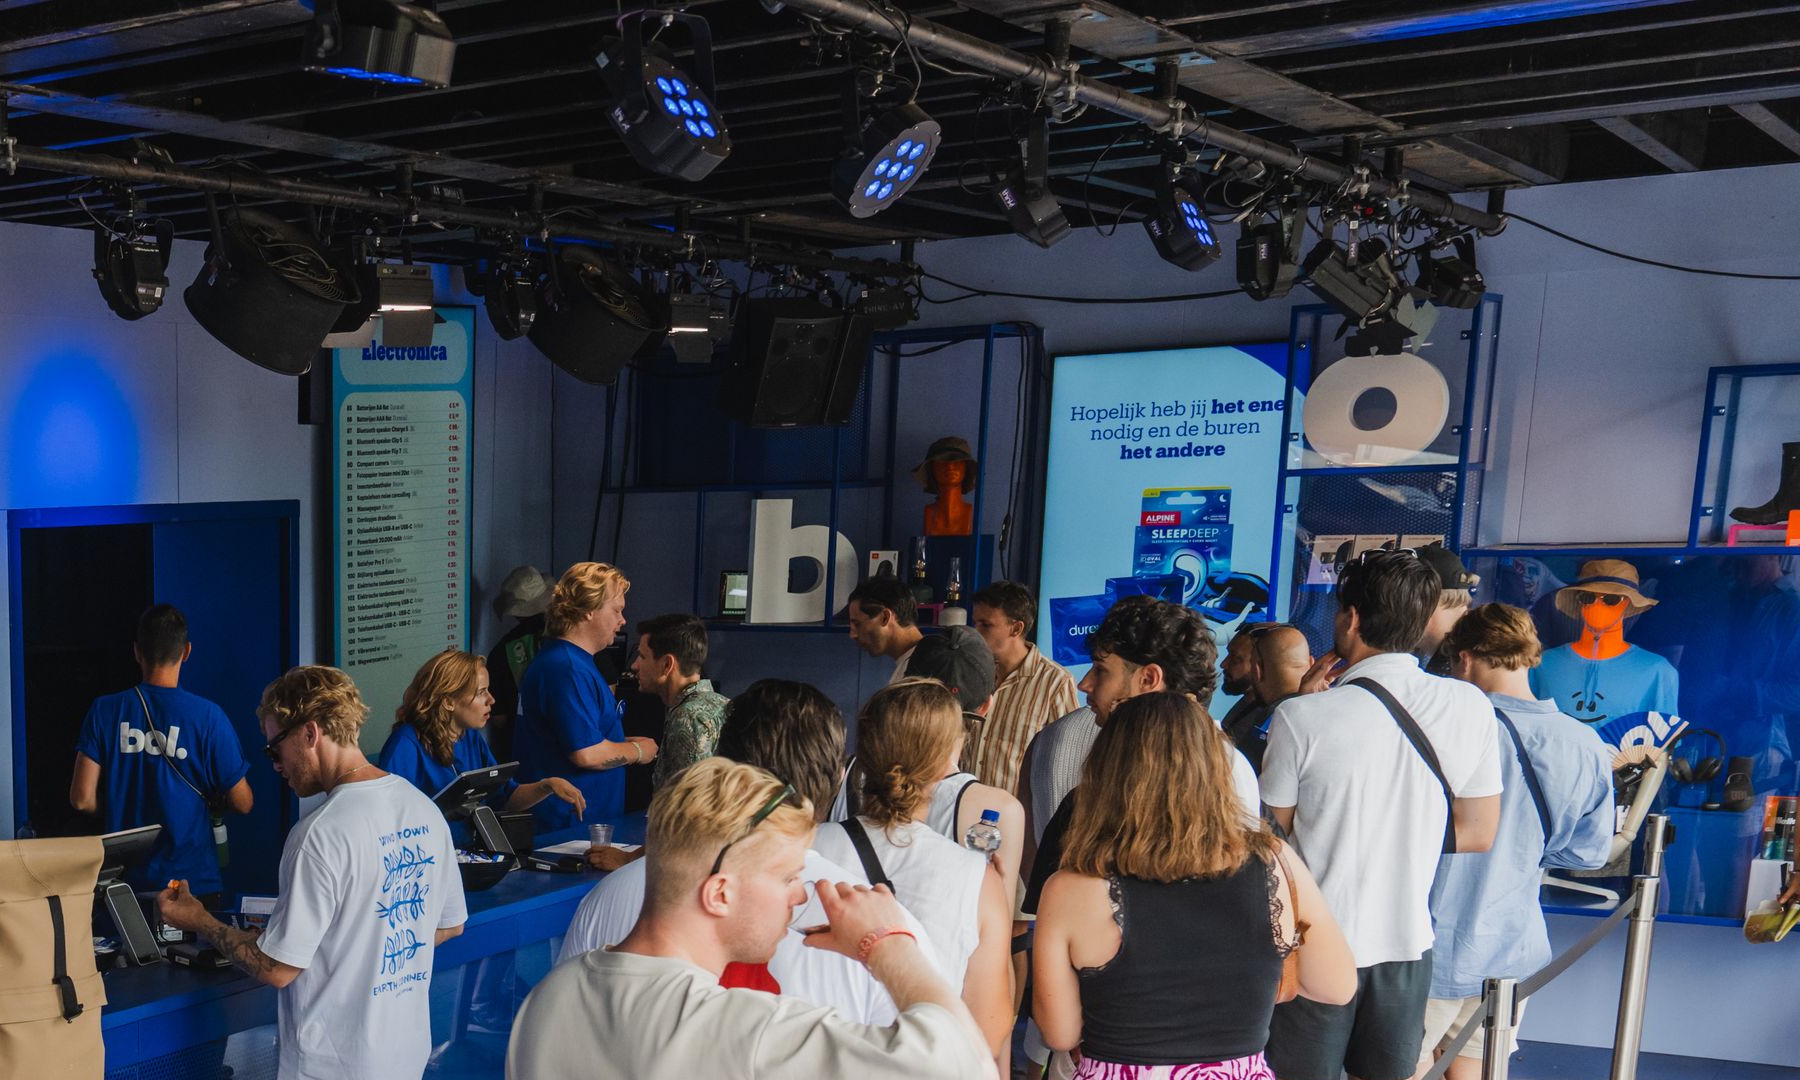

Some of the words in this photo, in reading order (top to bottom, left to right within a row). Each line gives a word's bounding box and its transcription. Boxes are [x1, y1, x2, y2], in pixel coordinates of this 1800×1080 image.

[1070, 403, 1146, 422] Hopelijk
[1151, 400, 1186, 417] heb
[1191, 400, 1208, 419] jij
[1211, 398, 1244, 415] het
[1248, 398, 1285, 413] ene
[1090, 423, 1143, 442] nodig
[1148, 424, 1171, 438] en
[1176, 421, 1199, 437] de
[1204, 420, 1260, 436] buren
[1120, 445, 1153, 460] het
[1156, 443, 1226, 458] andere
[1146, 514, 1175, 522] ALPINE
[1151, 528, 1219, 539] SLEEPDEEP
[749, 498, 859, 624] b
[1069, 624, 1100, 636] dure
[120, 721, 188, 760] bol.
